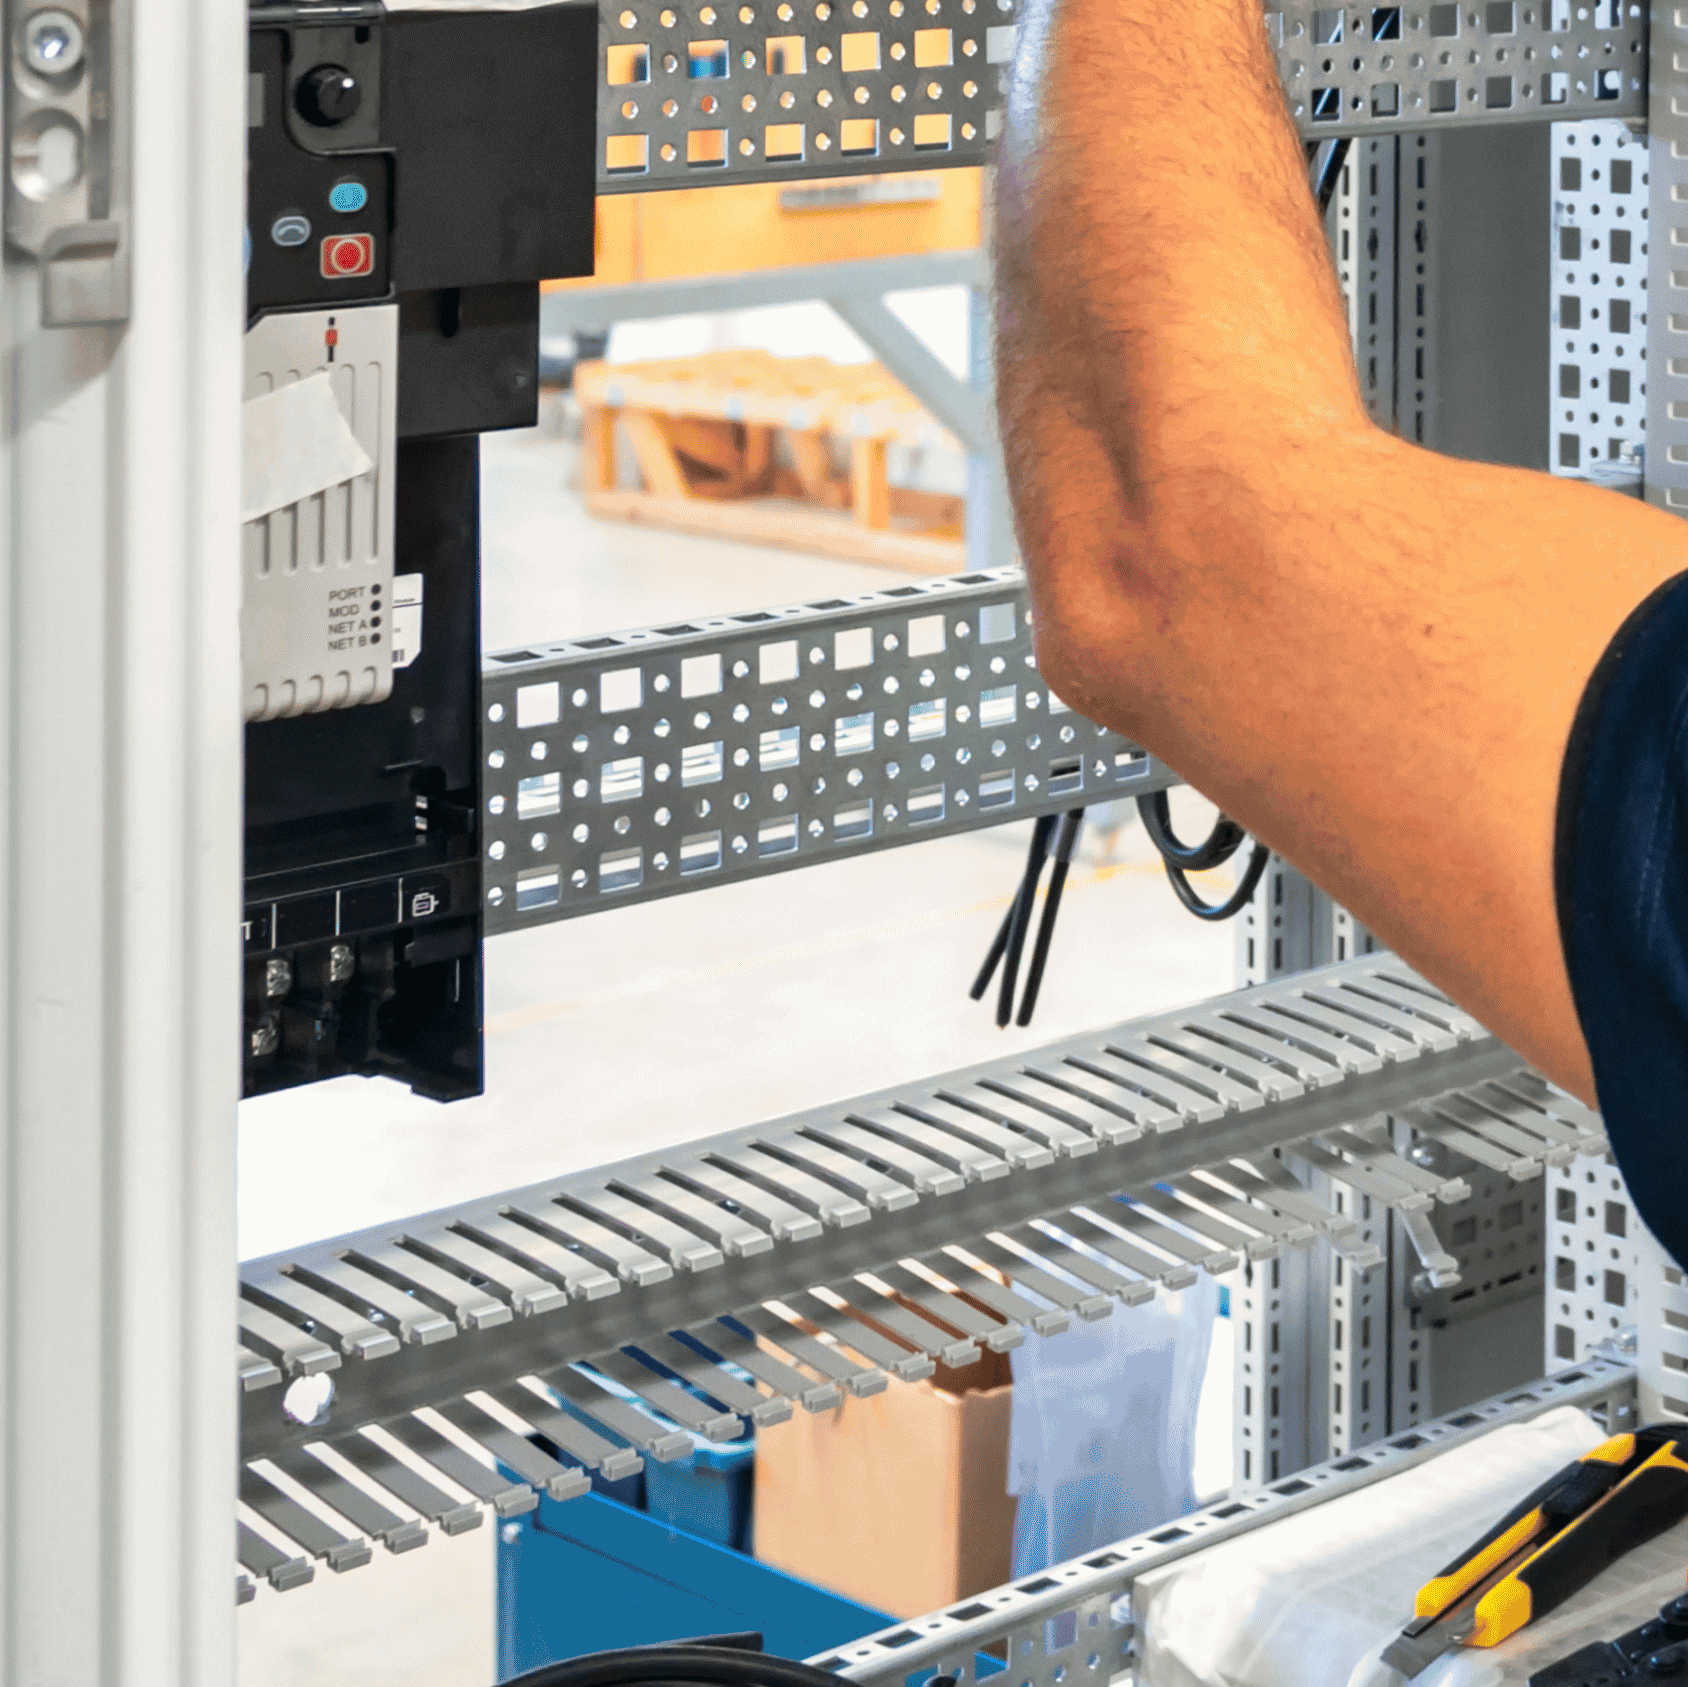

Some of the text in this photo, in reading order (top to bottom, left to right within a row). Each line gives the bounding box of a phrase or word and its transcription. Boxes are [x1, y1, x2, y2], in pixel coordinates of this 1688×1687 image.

[329, 586, 366, 602] PORT
[329, 604, 360, 618] MOD
[328, 619, 368, 634] NET A
[328, 635, 367, 651] NET B
